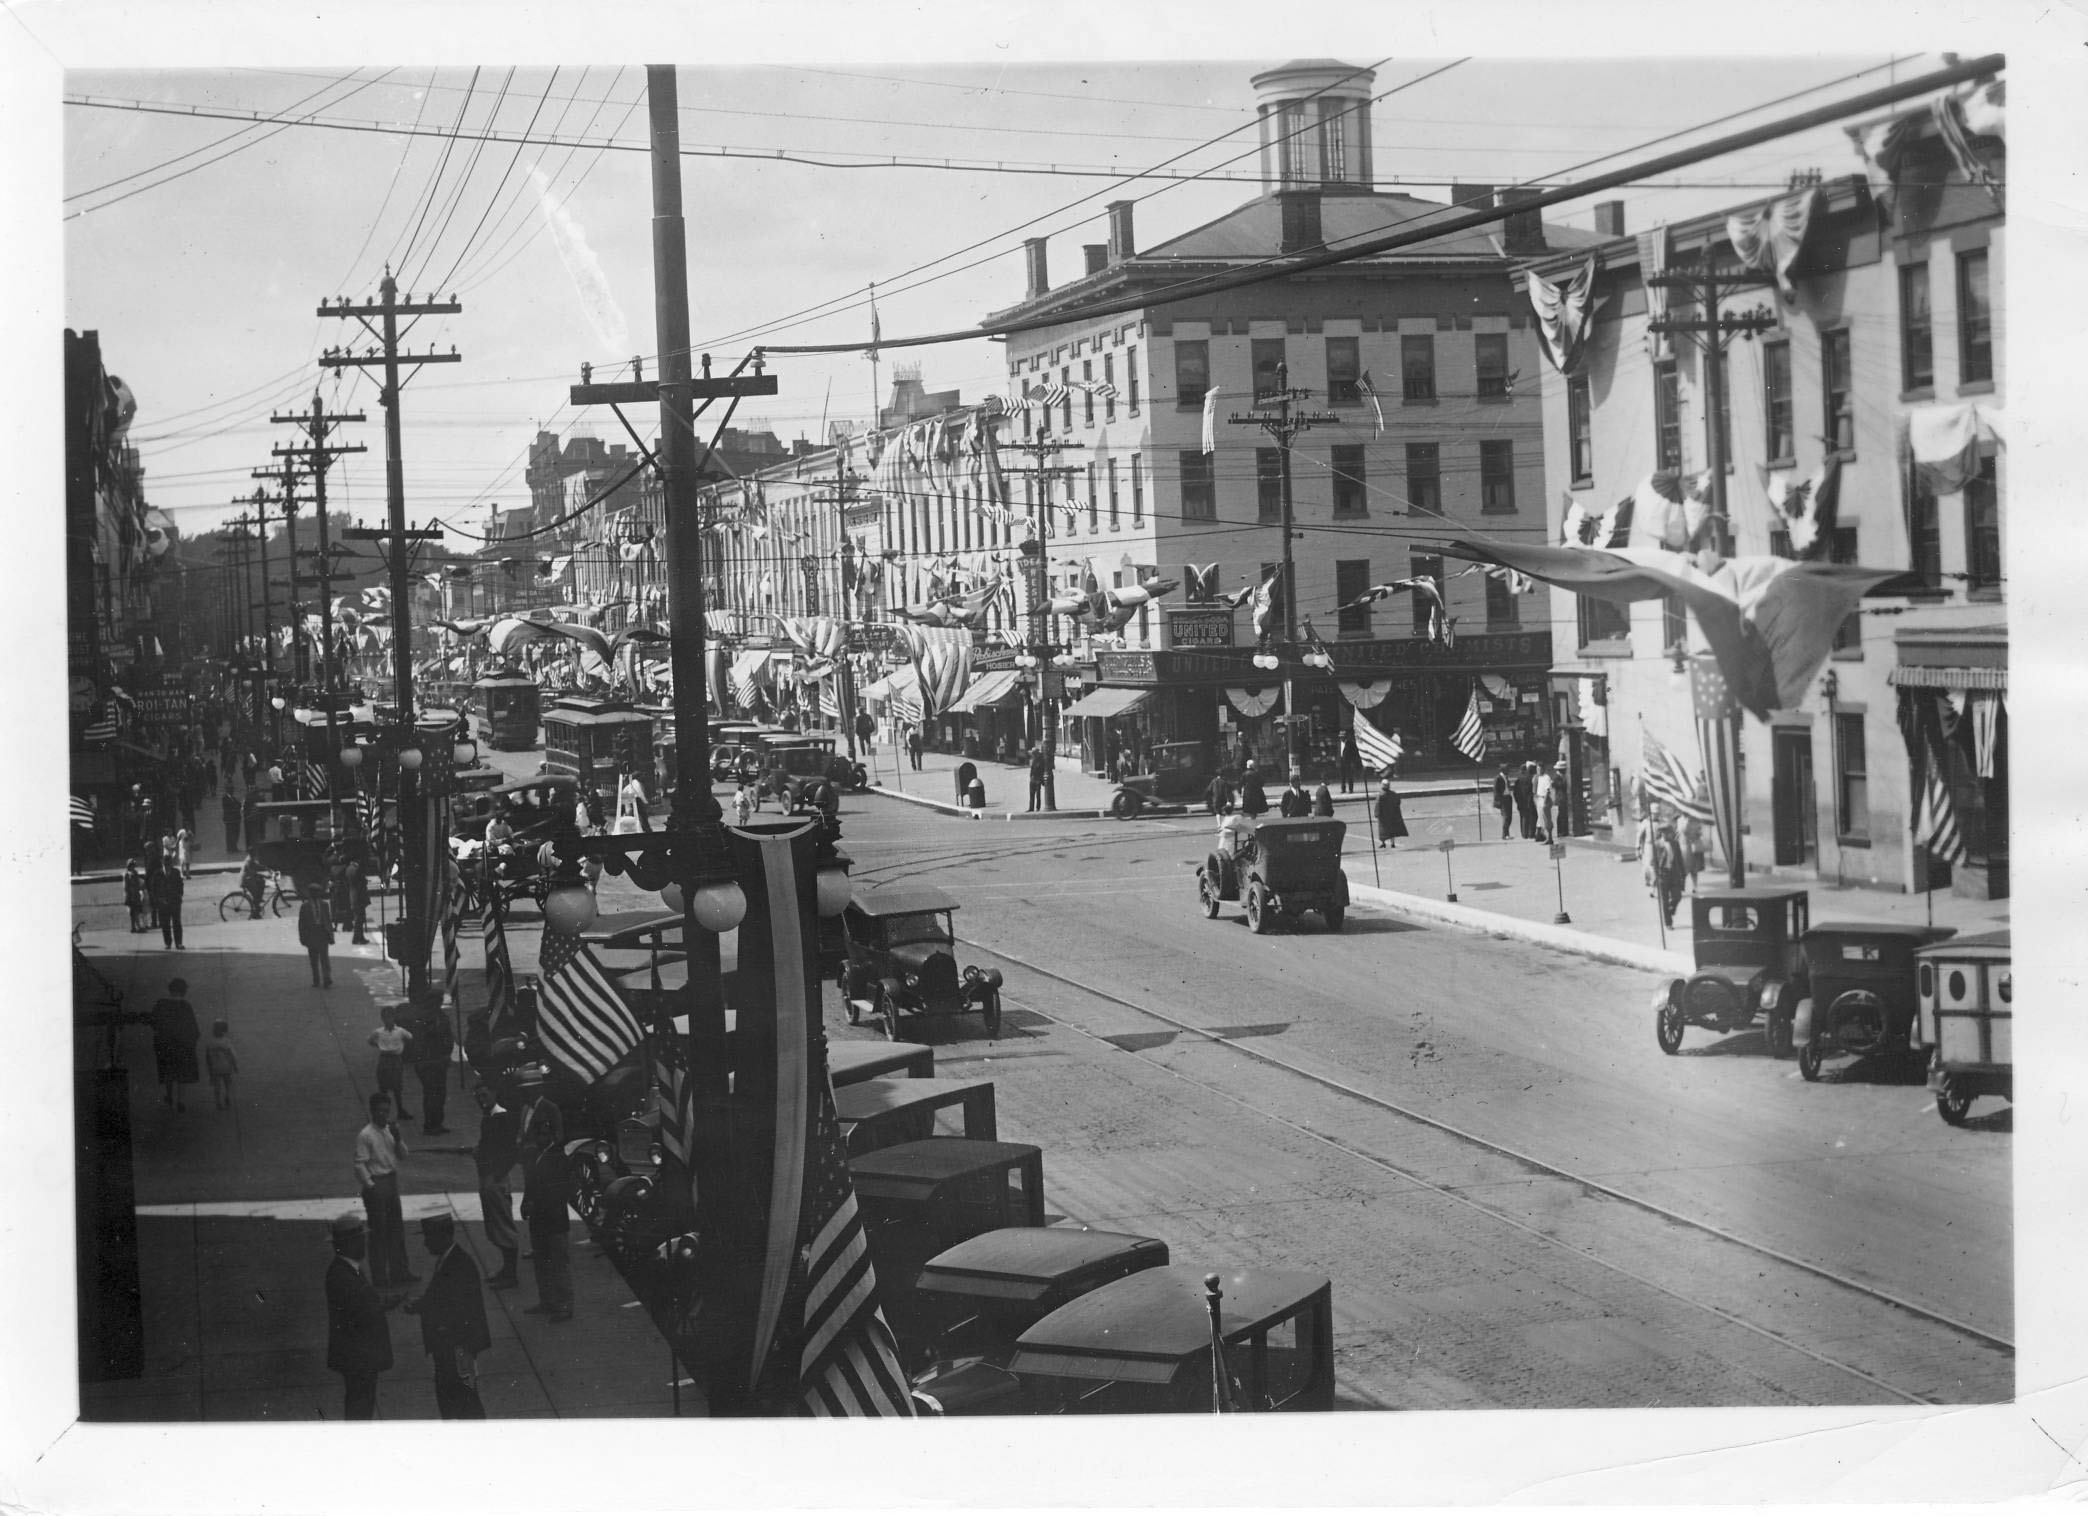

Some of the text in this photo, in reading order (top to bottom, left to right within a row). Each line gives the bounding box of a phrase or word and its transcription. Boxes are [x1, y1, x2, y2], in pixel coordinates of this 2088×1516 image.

[1173, 623, 1229, 638] UNITED
[1181, 636, 1222, 645] CIGARS
[1172, 655, 1231, 673] UNITED
[136, 697, 188, 712] ROI-TAN
[143, 712, 184, 721] CIGARS
